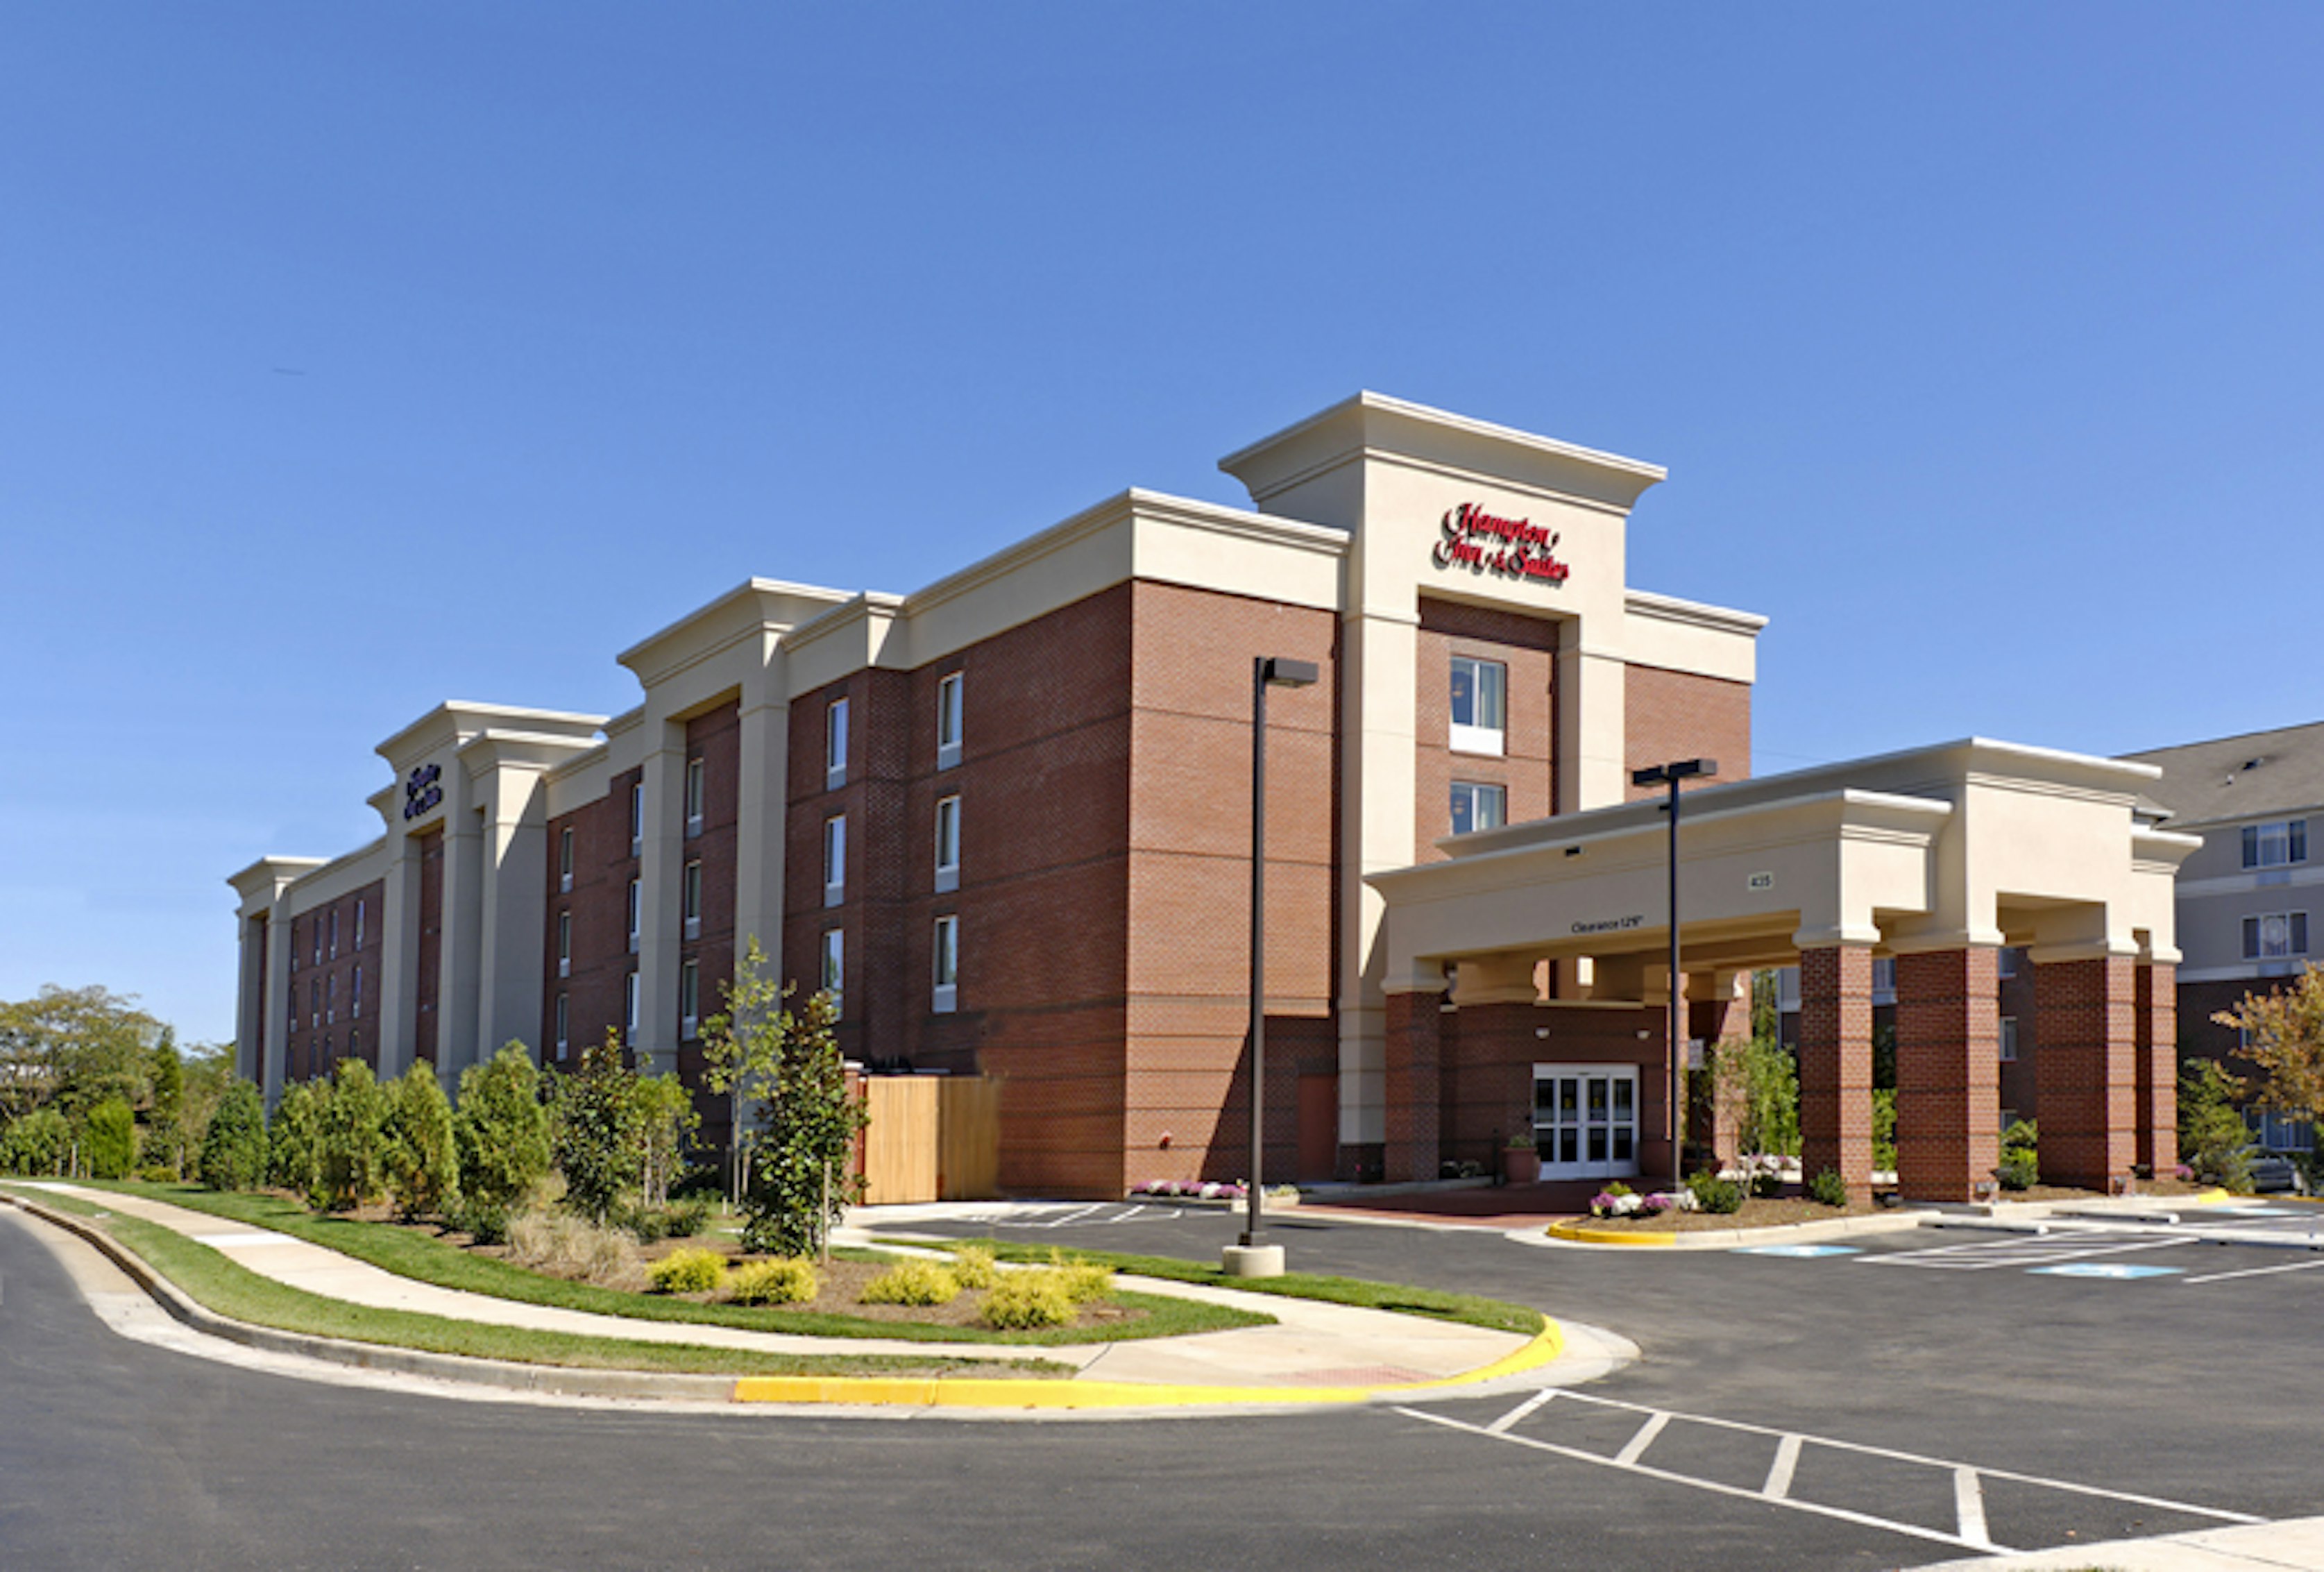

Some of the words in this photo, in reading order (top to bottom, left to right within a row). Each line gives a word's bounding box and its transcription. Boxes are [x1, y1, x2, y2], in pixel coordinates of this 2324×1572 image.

[1442, 503, 1559, 552] Hampton
[1432, 536, 1484, 573] Inn
[1509, 546, 1568, 582] Suites
[1571, 920, 1619, 933] Clearance
